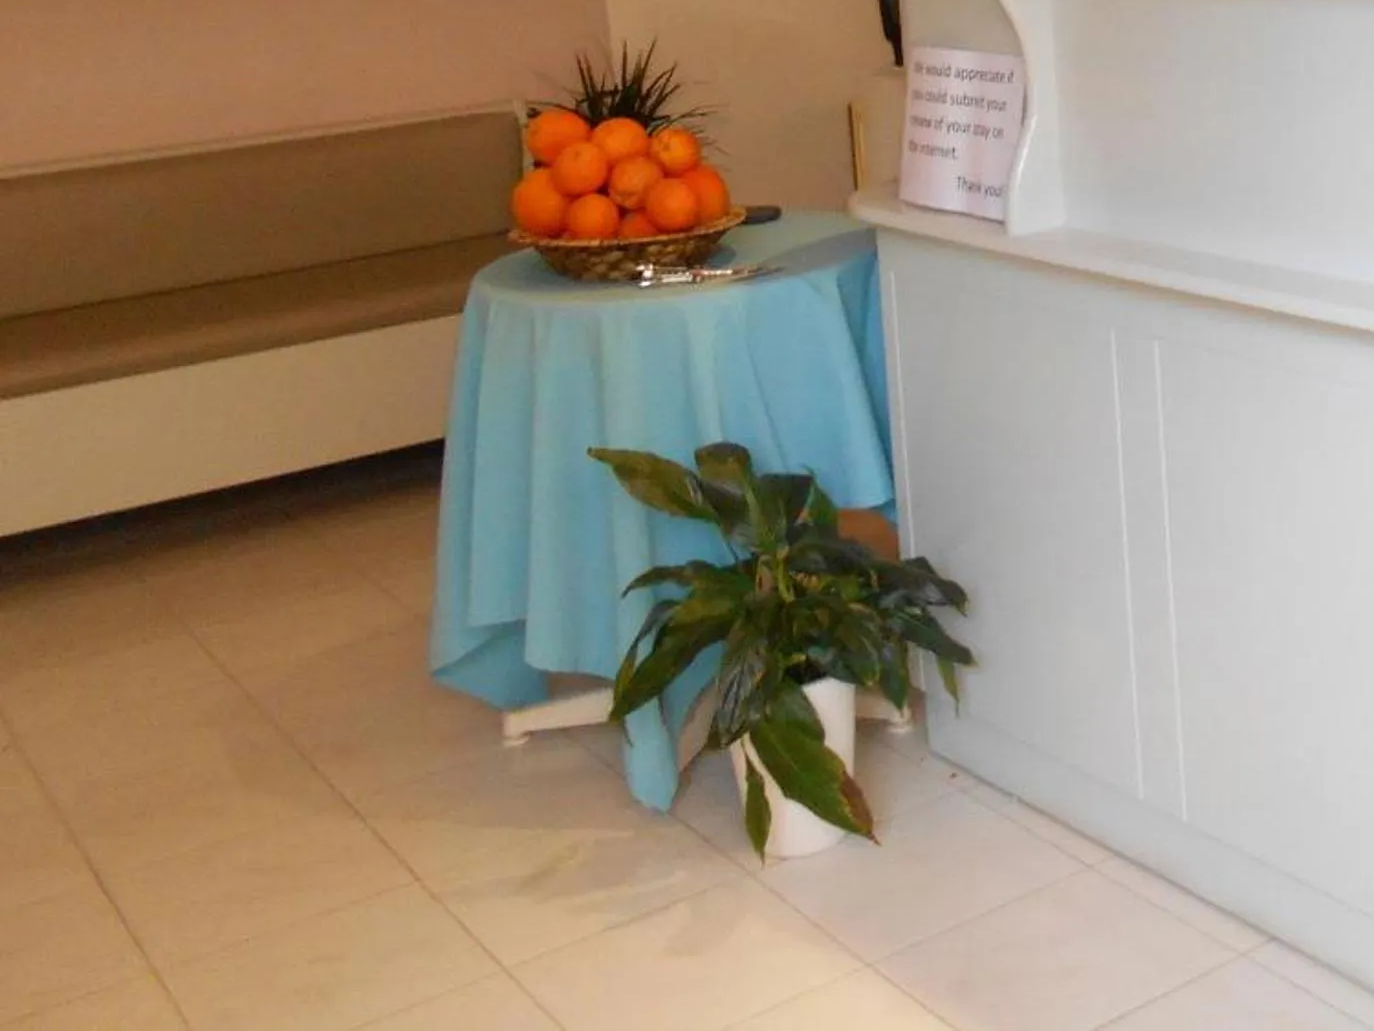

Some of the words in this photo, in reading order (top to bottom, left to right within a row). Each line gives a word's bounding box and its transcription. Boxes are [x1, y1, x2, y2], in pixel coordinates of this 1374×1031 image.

[925, 62, 951, 79] would
[954, 67, 1005, 84] appreciate
[925, 89, 948, 105] could
[950, 93, 985, 109] submit
[986, 98, 1007, 113] your
[934, 116, 944, 133] of
[946, 121, 971, 136] your
[992, 127, 1005, 140] on
[957, 175, 982, 194] Thank
